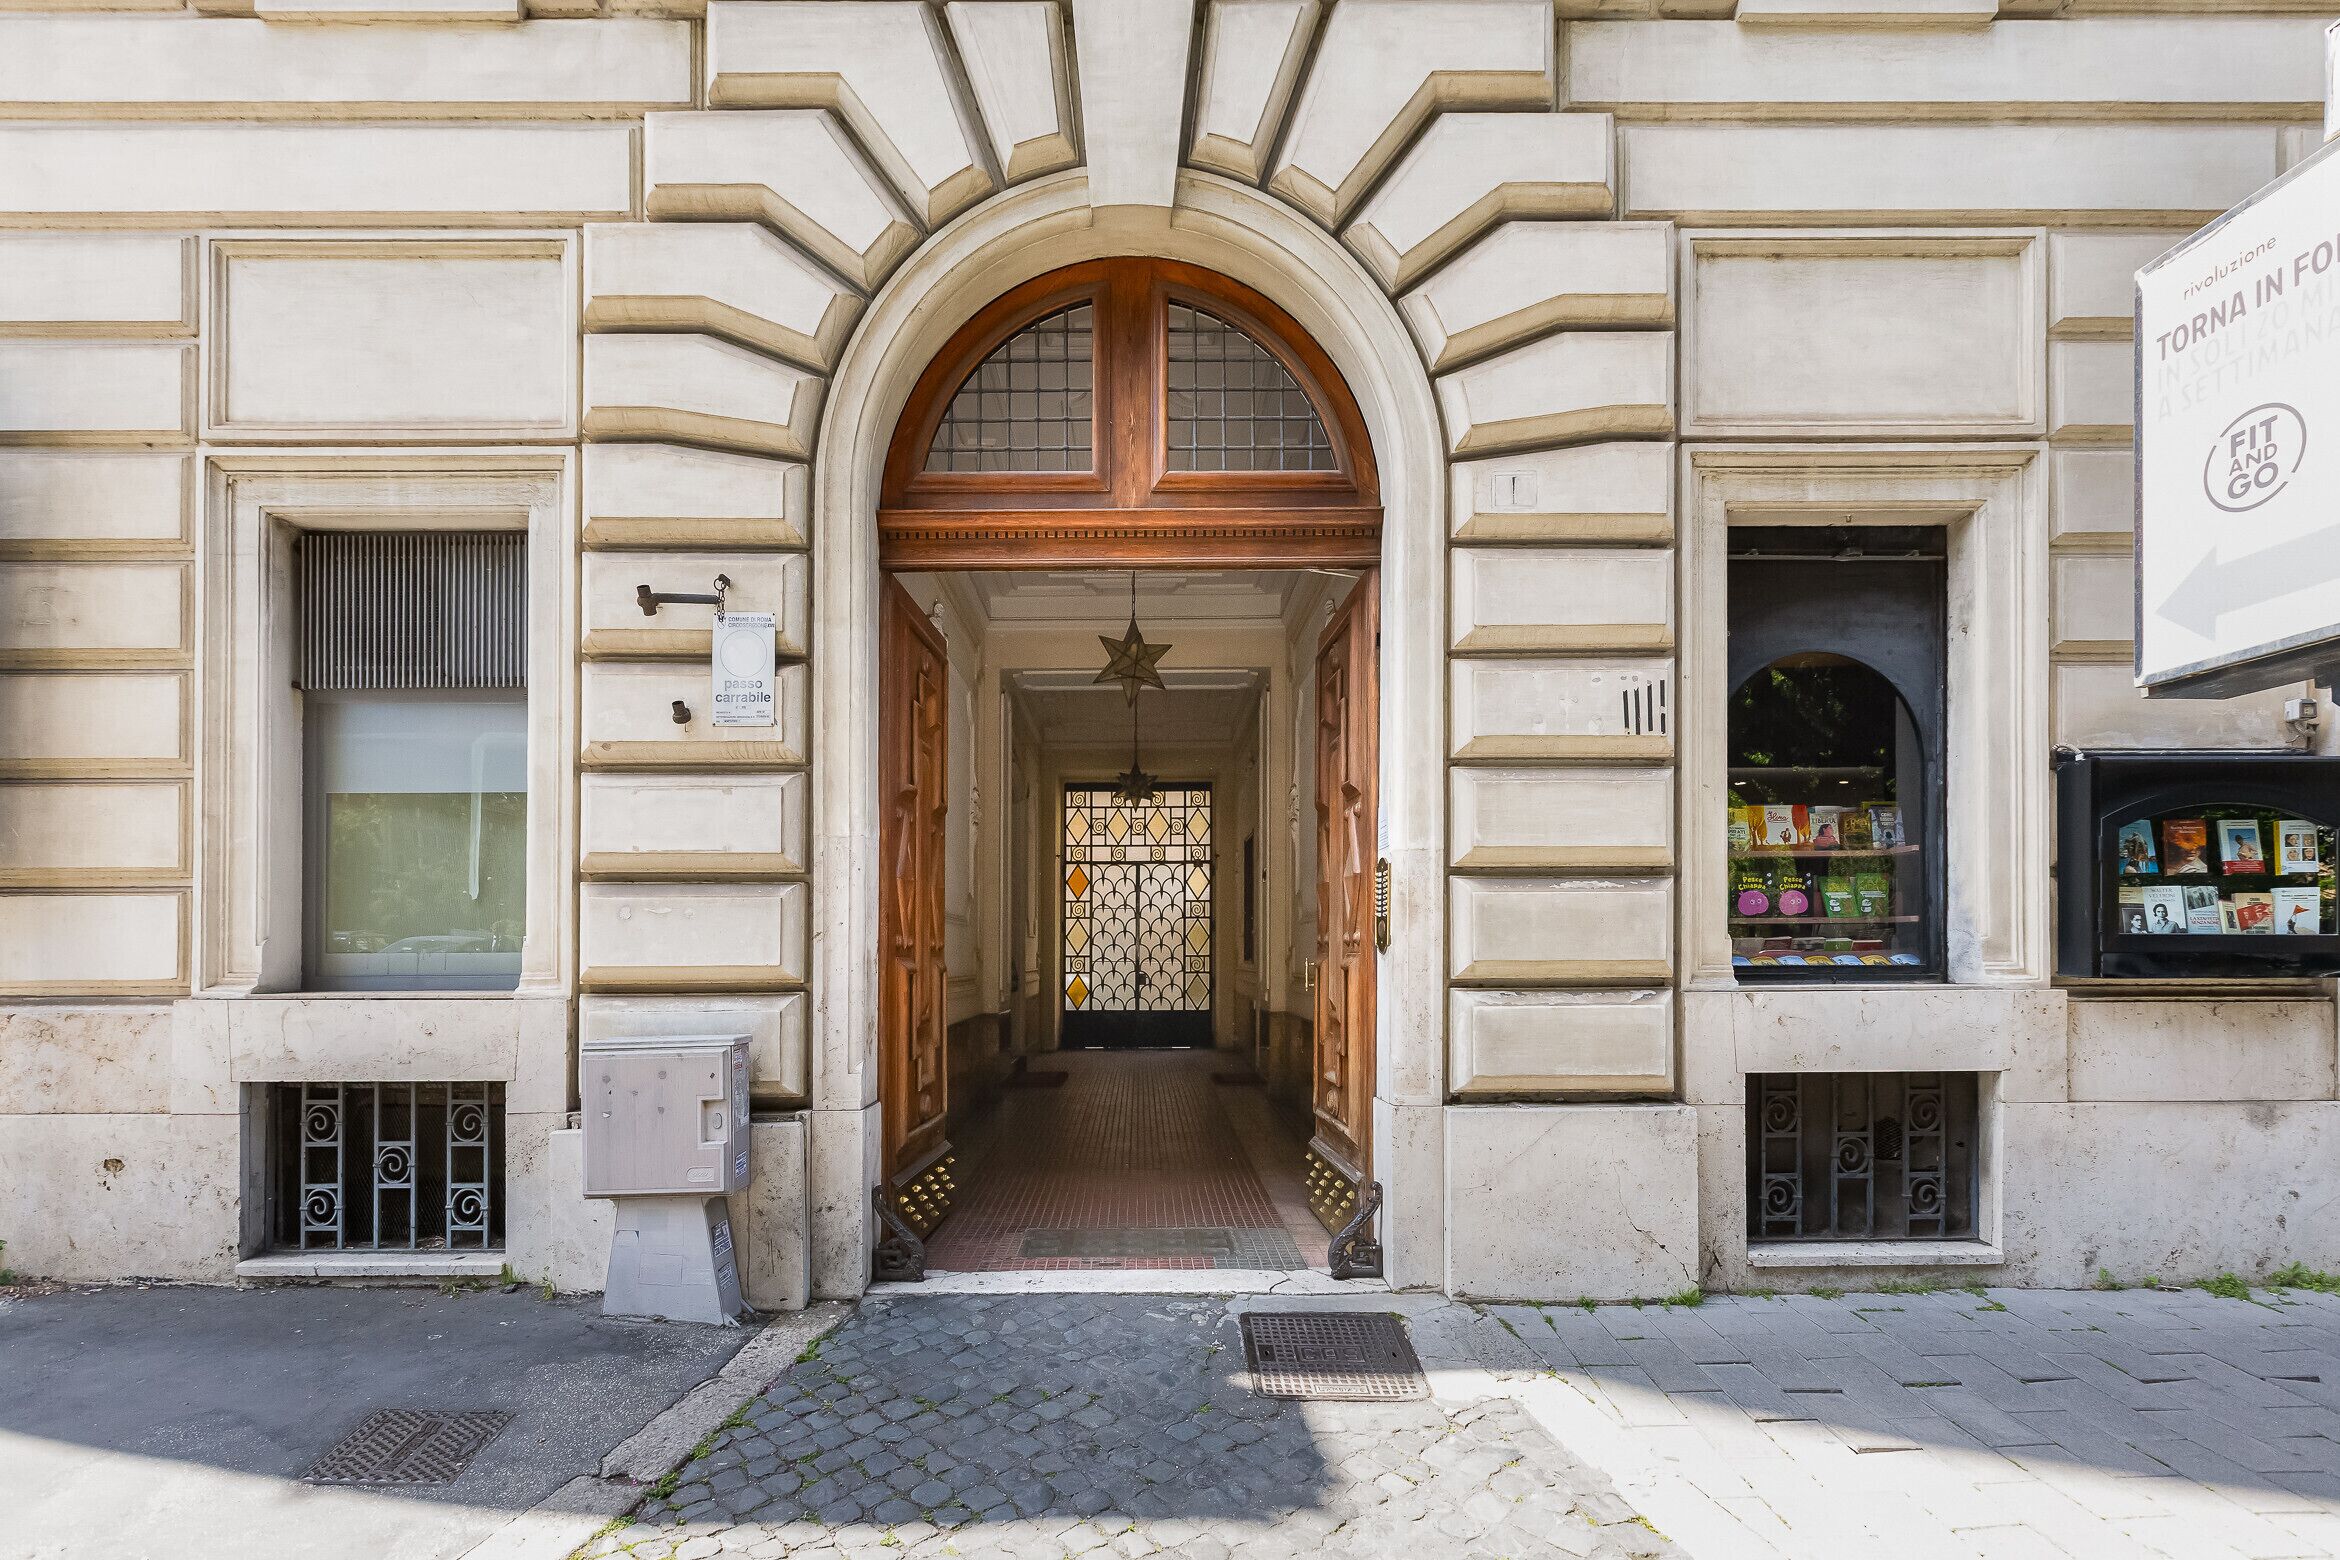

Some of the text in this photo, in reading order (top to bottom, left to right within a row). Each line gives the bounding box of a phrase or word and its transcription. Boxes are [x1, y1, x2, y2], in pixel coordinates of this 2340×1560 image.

[2184, 237, 2277, 300] rivoluzione
[2156, 233, 2340, 361] TORNA IN FO
[2158, 358, 2181, 392] IN
[2190, 322, 2246, 377] SOLI
[2158, 395, 2172, 423] A
[2230, 415, 2278, 458] FIT
[2229, 443, 2278, 476] AND
[2227, 462, 2279, 499] GO
[715, 691, 771, 703] carrabile
[724, 680, 763, 691] passo
[1738, 883, 1767, 891] Chiappa
[1779, 883, 1806, 891] Chiappa
